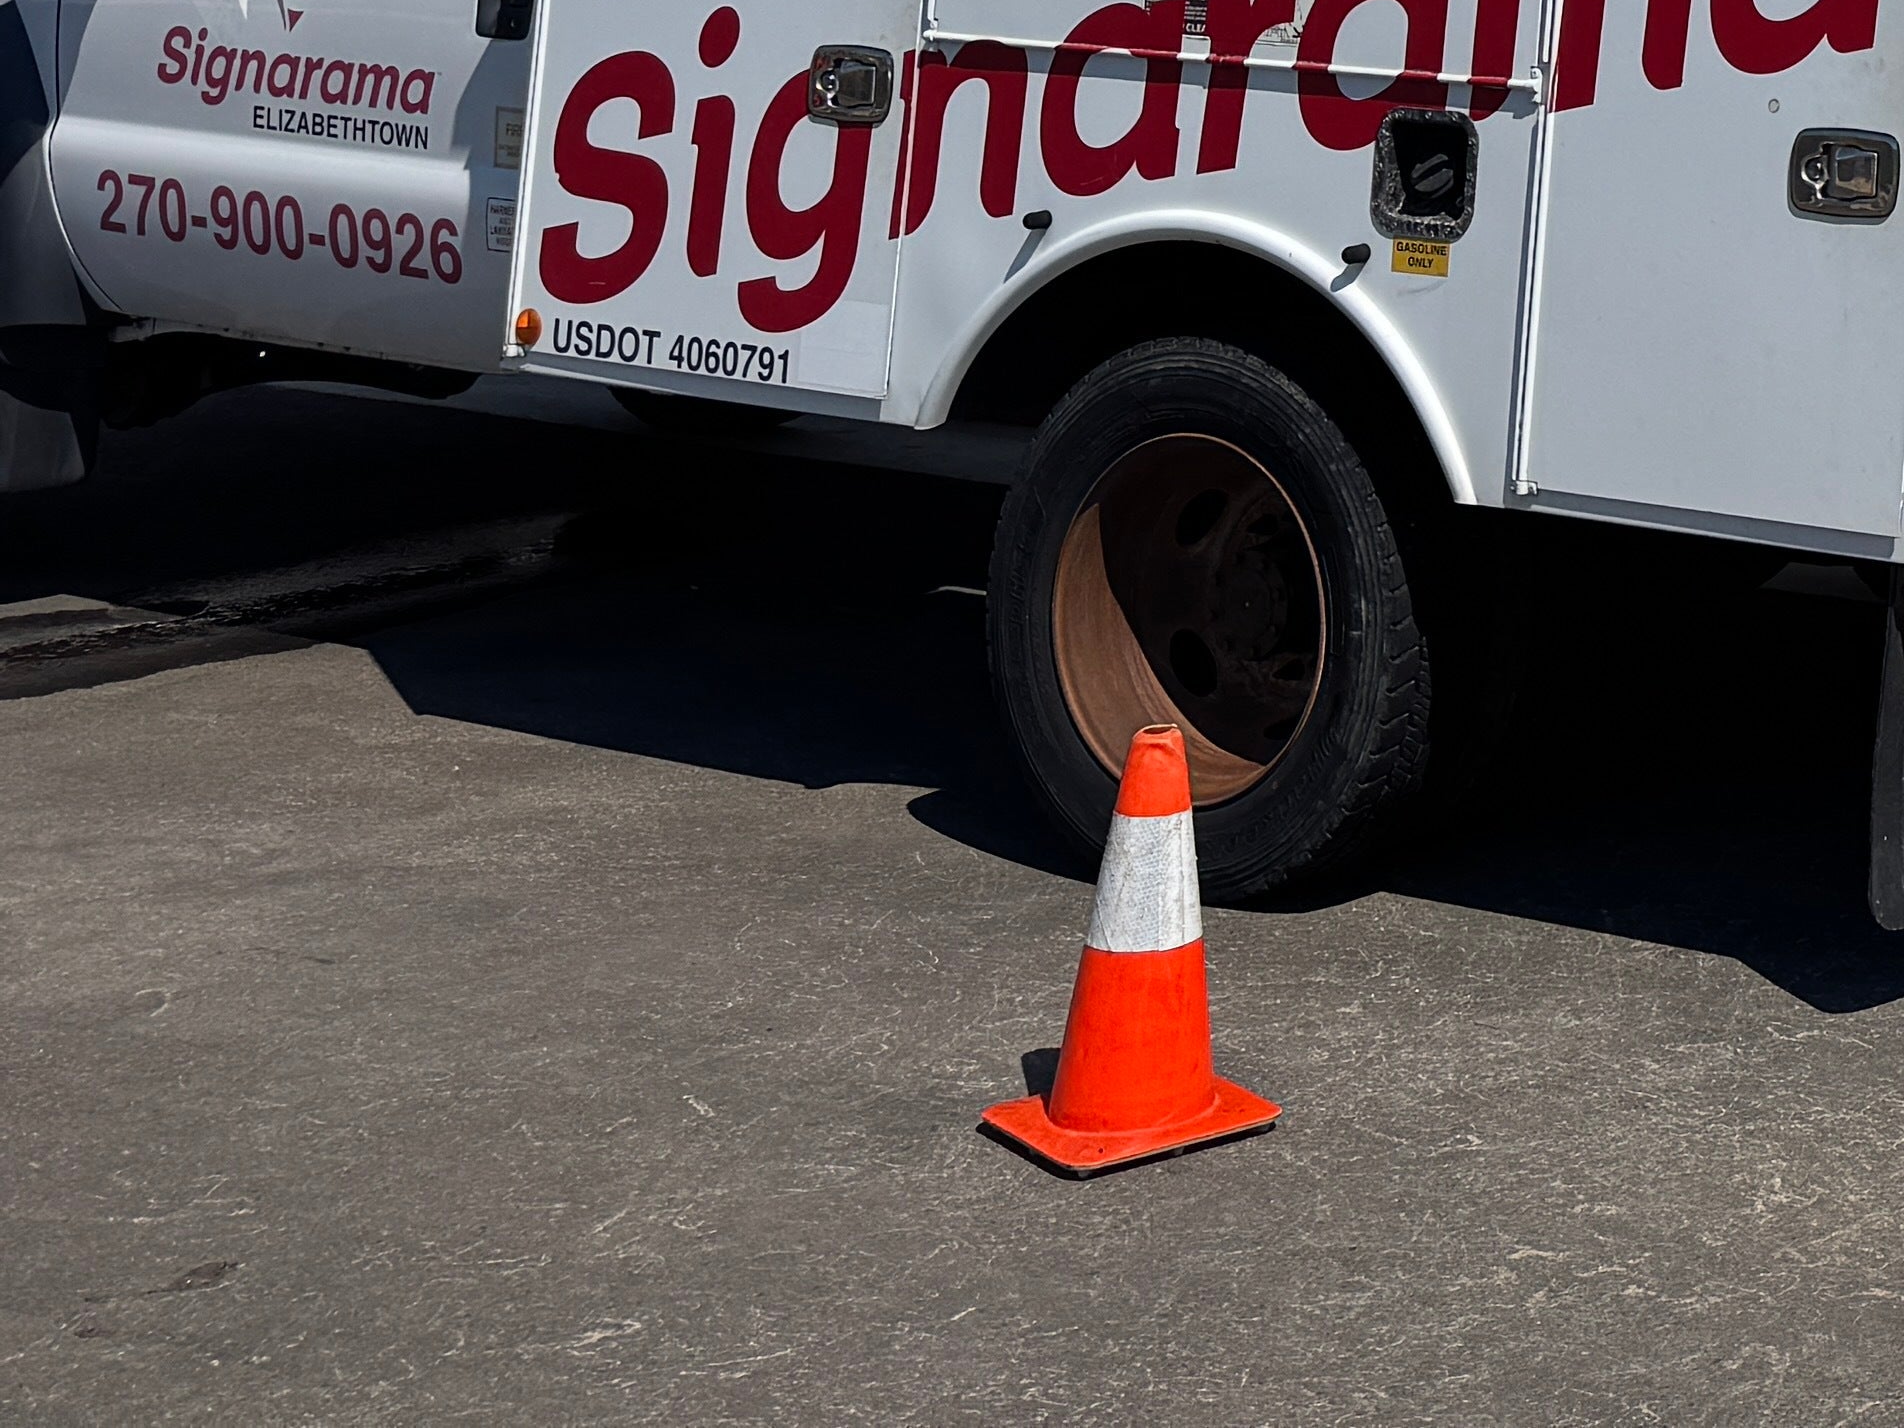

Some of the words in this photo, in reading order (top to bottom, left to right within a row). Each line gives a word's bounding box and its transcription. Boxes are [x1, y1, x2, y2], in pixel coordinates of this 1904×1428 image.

[157, 25, 436, 115] Signarama
[252, 105, 429, 150] ELIZABETHTOWN
[96, 168, 463, 285] 270-900-0926
[1396, 241, 1447, 256] GASOLINE
[1407, 256, 1434, 268] ONLY
[552, 317, 661, 365] USDOT
[668, 334, 790, 384] 4060791
